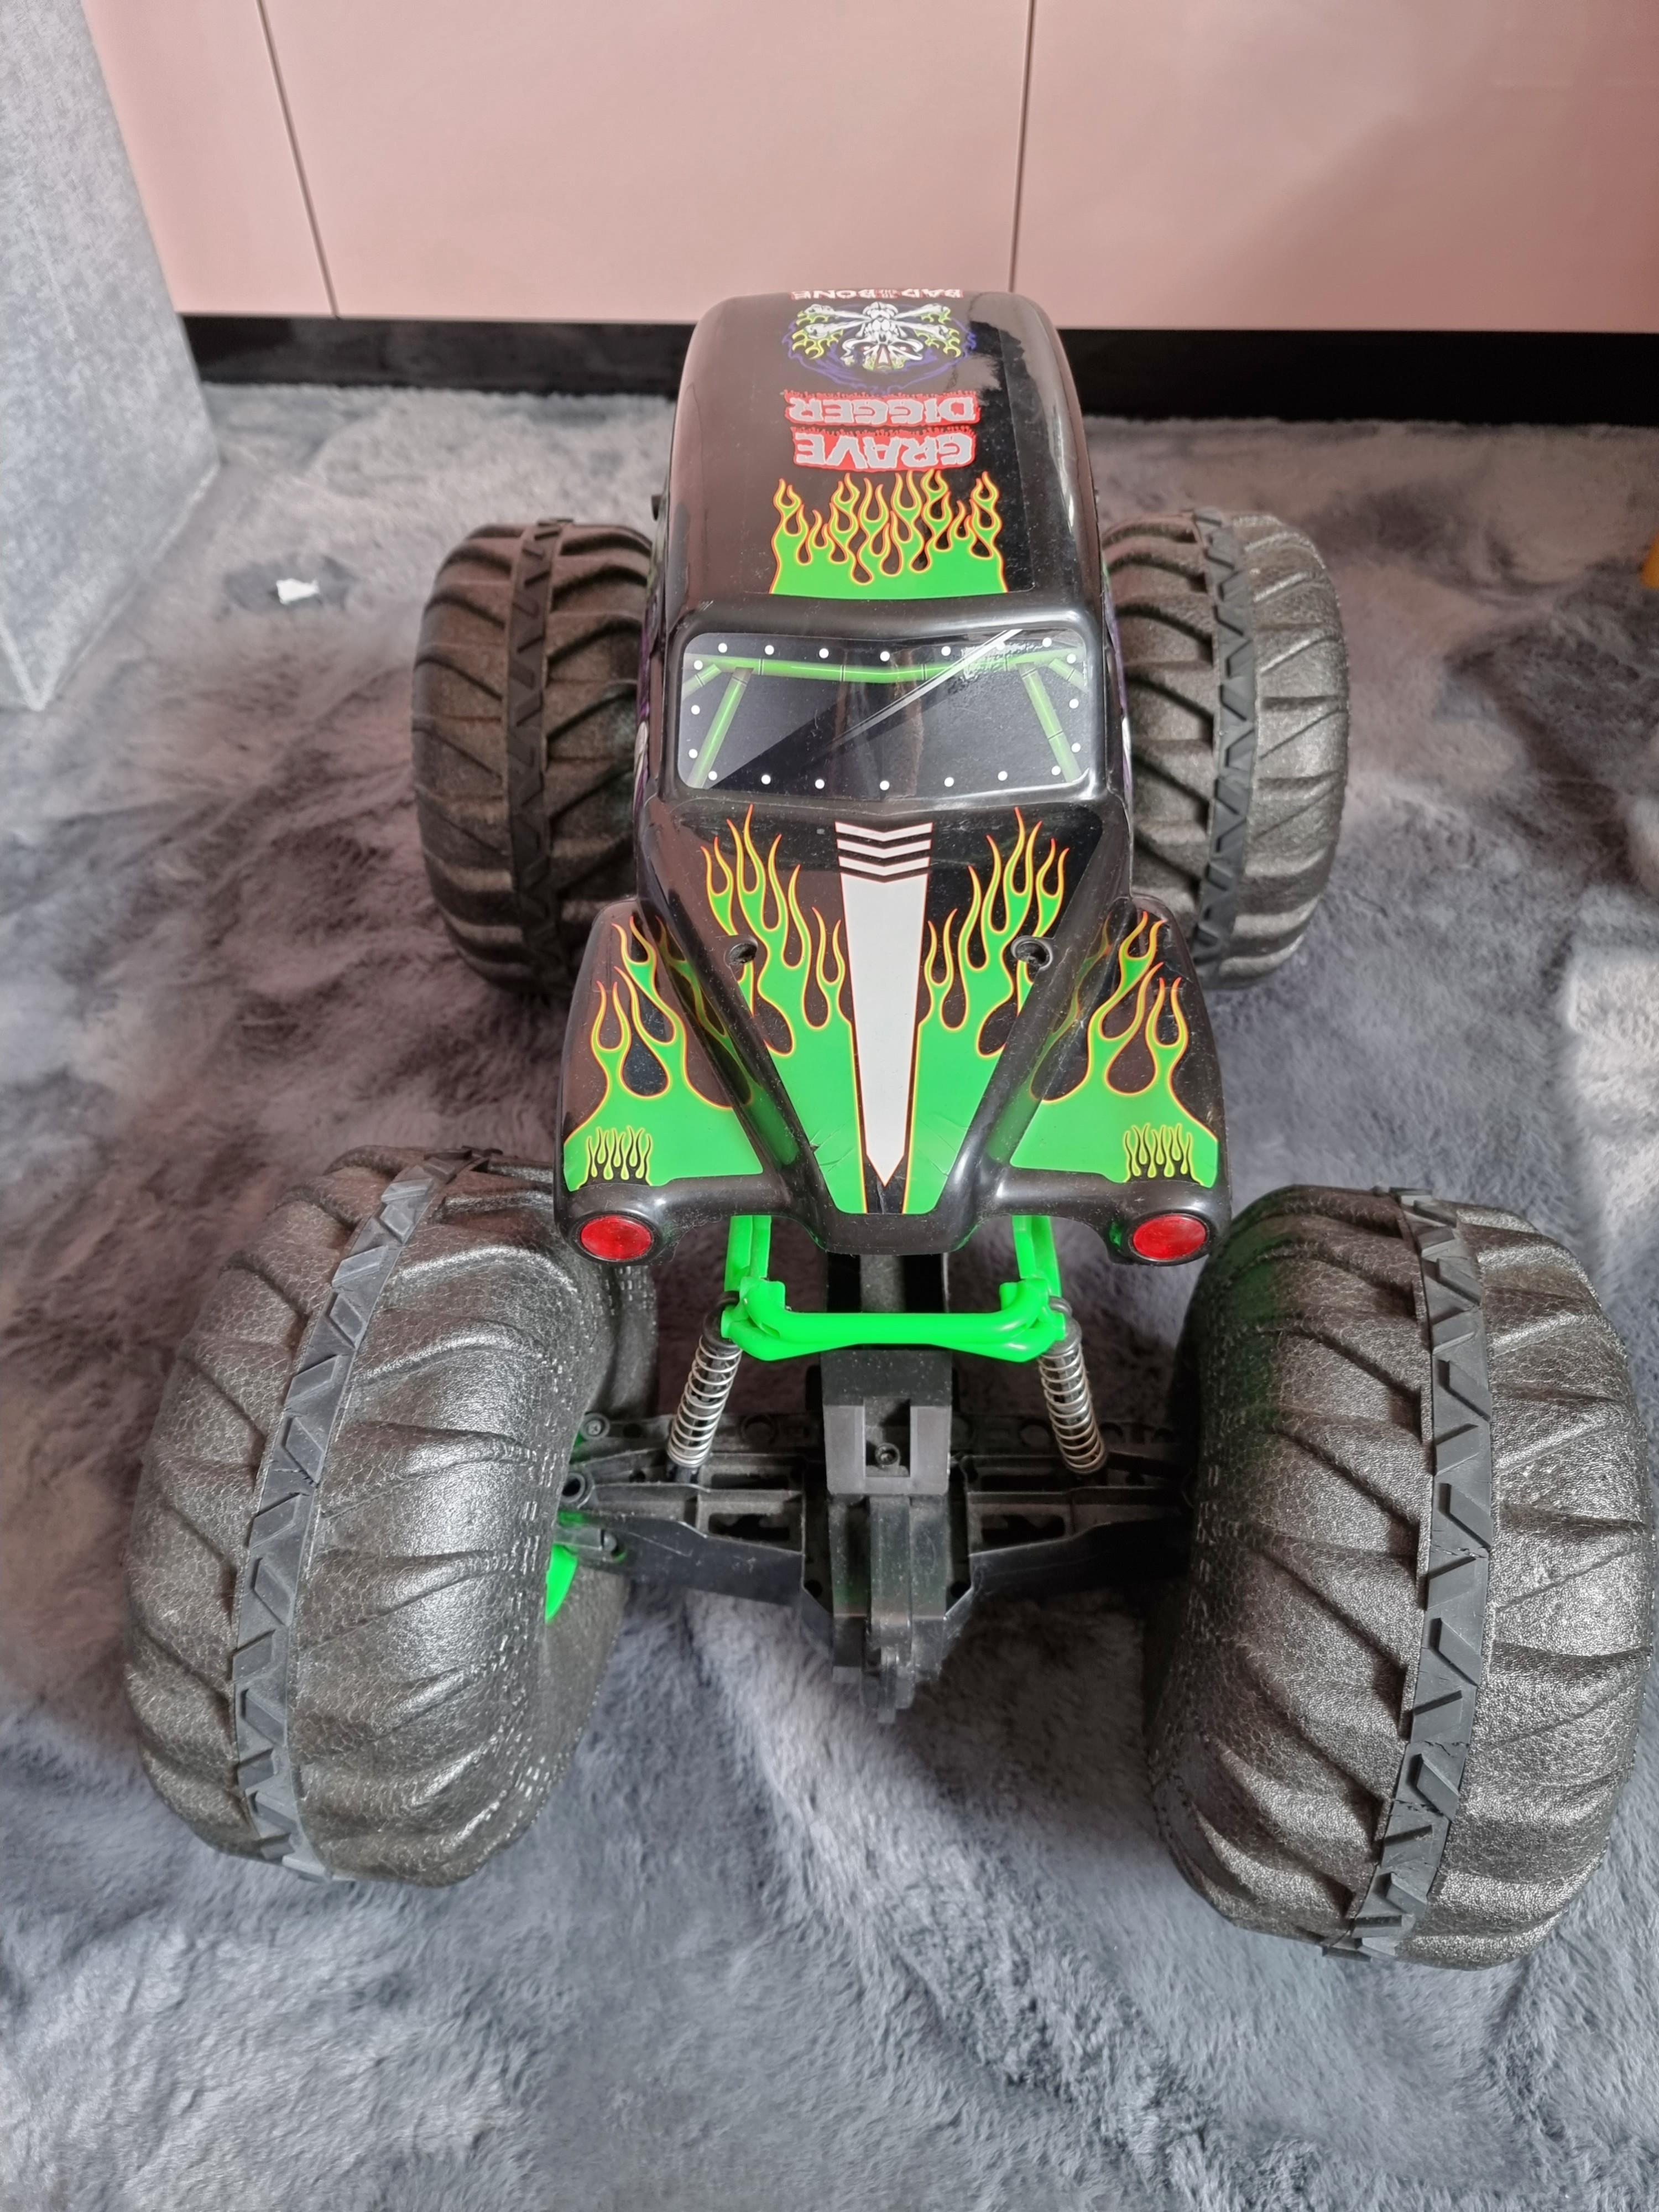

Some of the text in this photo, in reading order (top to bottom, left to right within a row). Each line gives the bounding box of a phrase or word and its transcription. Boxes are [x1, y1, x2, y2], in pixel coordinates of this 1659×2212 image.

[791, 289, 876, 300] BONE
[901, 288, 962, 298] BAD
[788, 396, 977, 425] DIGGER
[794, 431, 974, 469] GRAVE
